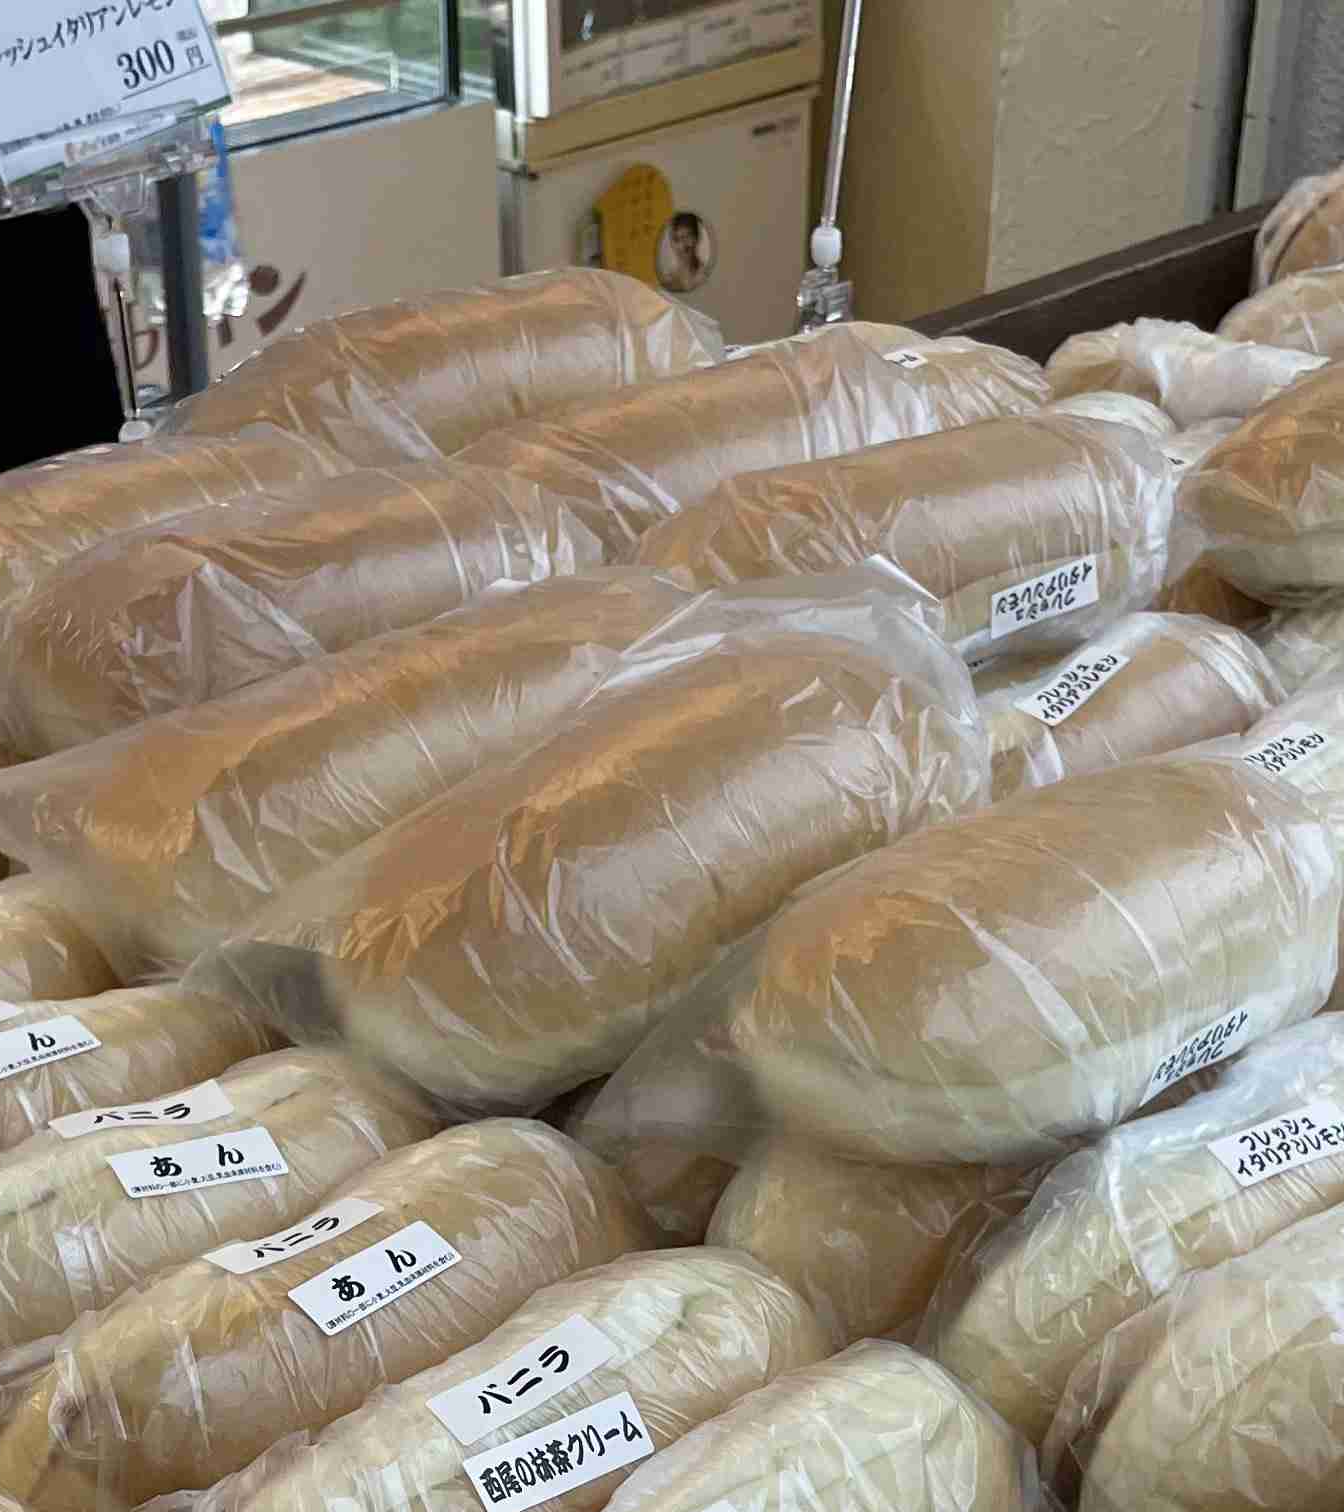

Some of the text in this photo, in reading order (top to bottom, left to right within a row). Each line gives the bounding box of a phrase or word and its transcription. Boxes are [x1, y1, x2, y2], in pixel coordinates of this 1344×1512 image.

[117, 39, 206, 89] 300 円
[1036, 663, 1089, 704] フレッシュ
[1043, 654, 1118, 720] イタリアンレモン
[1264, 731, 1325, 774] リアンレモン
[94, 1097, 191, 1124] バニラ
[1238, 1117, 1316, 1152] フレッシュ
[149, 1143, 245, 1178] あん
[253, 1213, 340, 1258] バニラ
[331, 1247, 416, 1302] あん
[477, 1345, 570, 1414] バニラ
[479, 1410, 643, 1504] 西尾の抹茶クリーム
